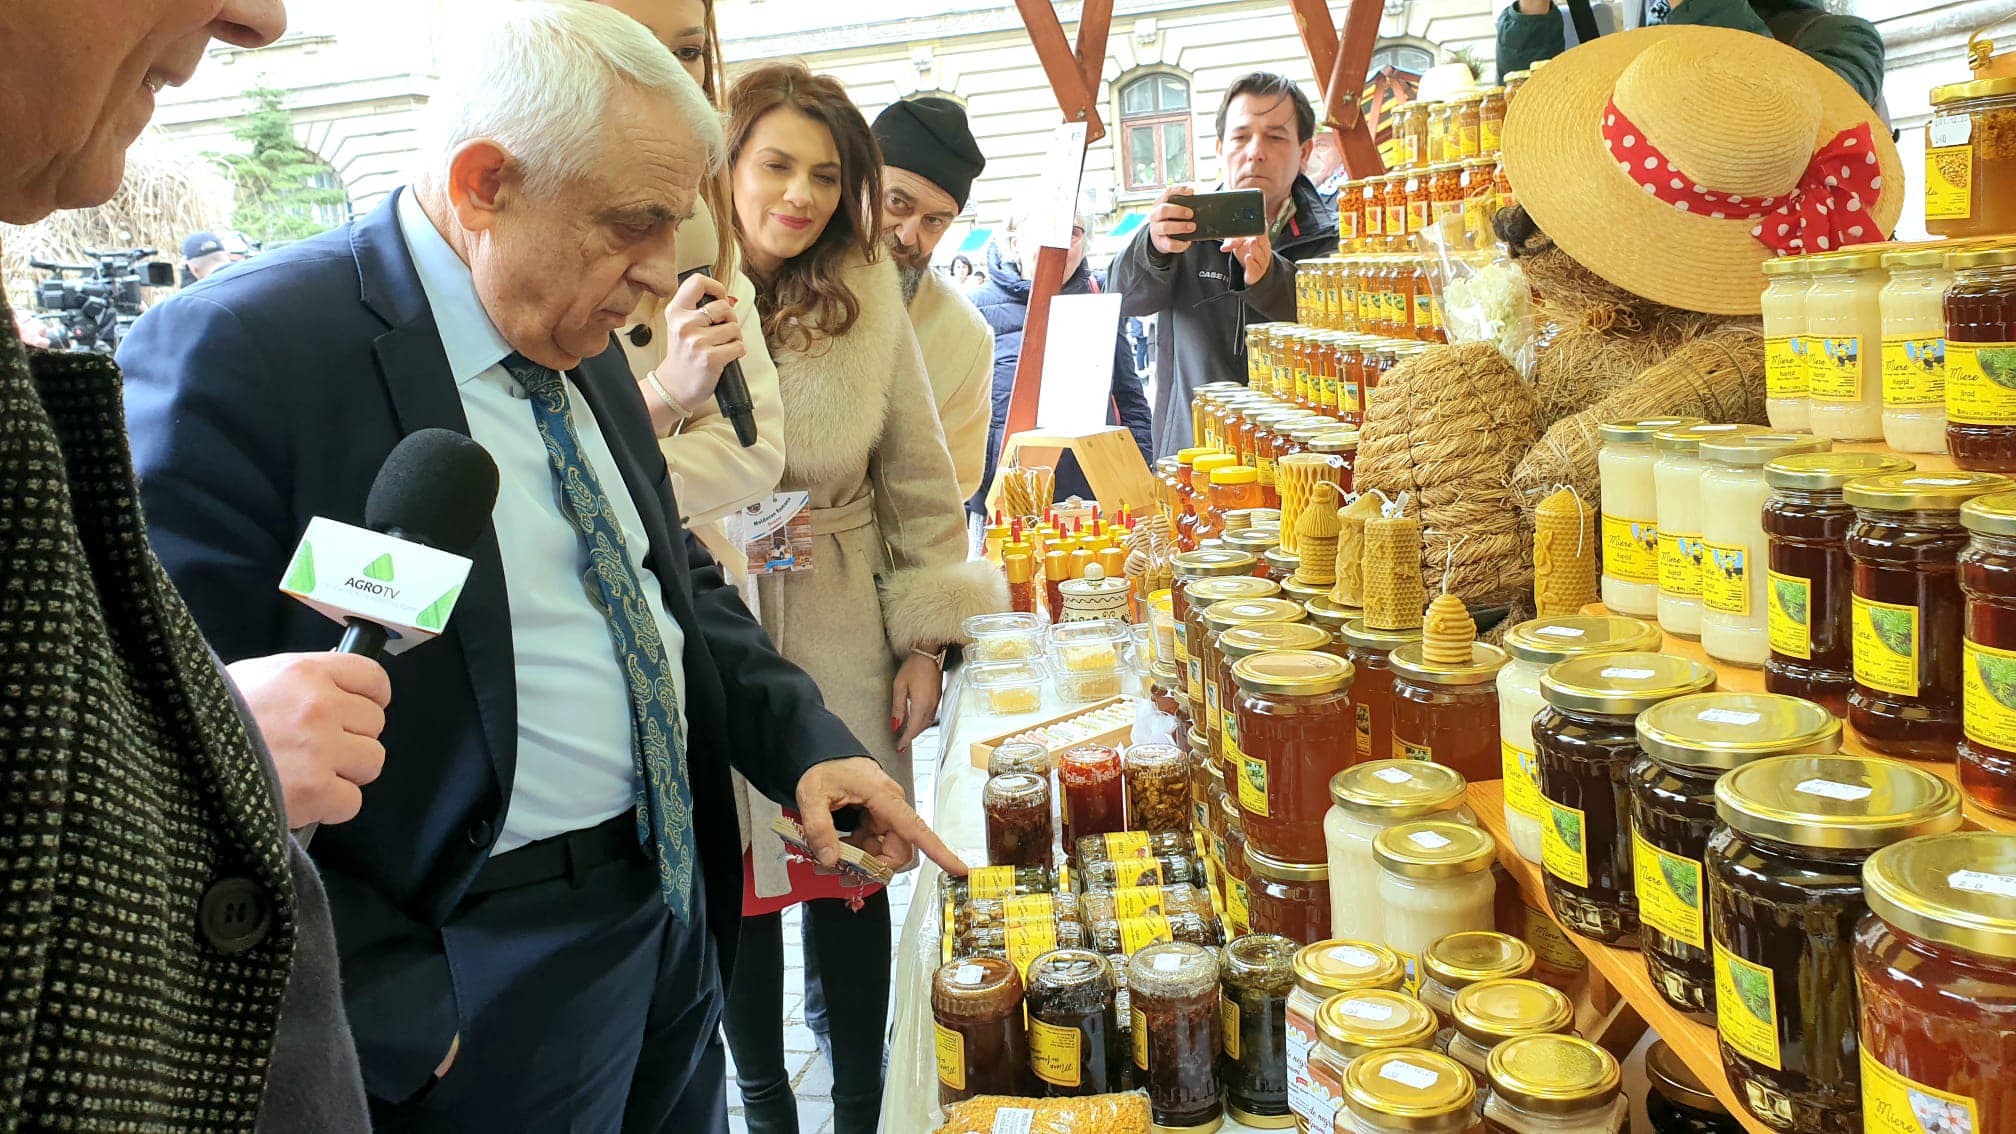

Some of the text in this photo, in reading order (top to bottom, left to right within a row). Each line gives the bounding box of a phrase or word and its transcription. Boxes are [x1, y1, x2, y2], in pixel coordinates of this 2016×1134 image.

[1199, 270, 1223, 280] CASE
[1885, 359, 1908, 371] Miere
[1950, 366, 1980, 381] Miere
[1609, 535, 1633, 548] Miere
[1661, 551, 1682, 564] Miere
[344, 576, 400, 600] AGROTV
[1639, 864, 1663, 886] Miere
[1535, 925, 1560, 940] Miere
[1876, 1097, 1916, 1133] Miere
